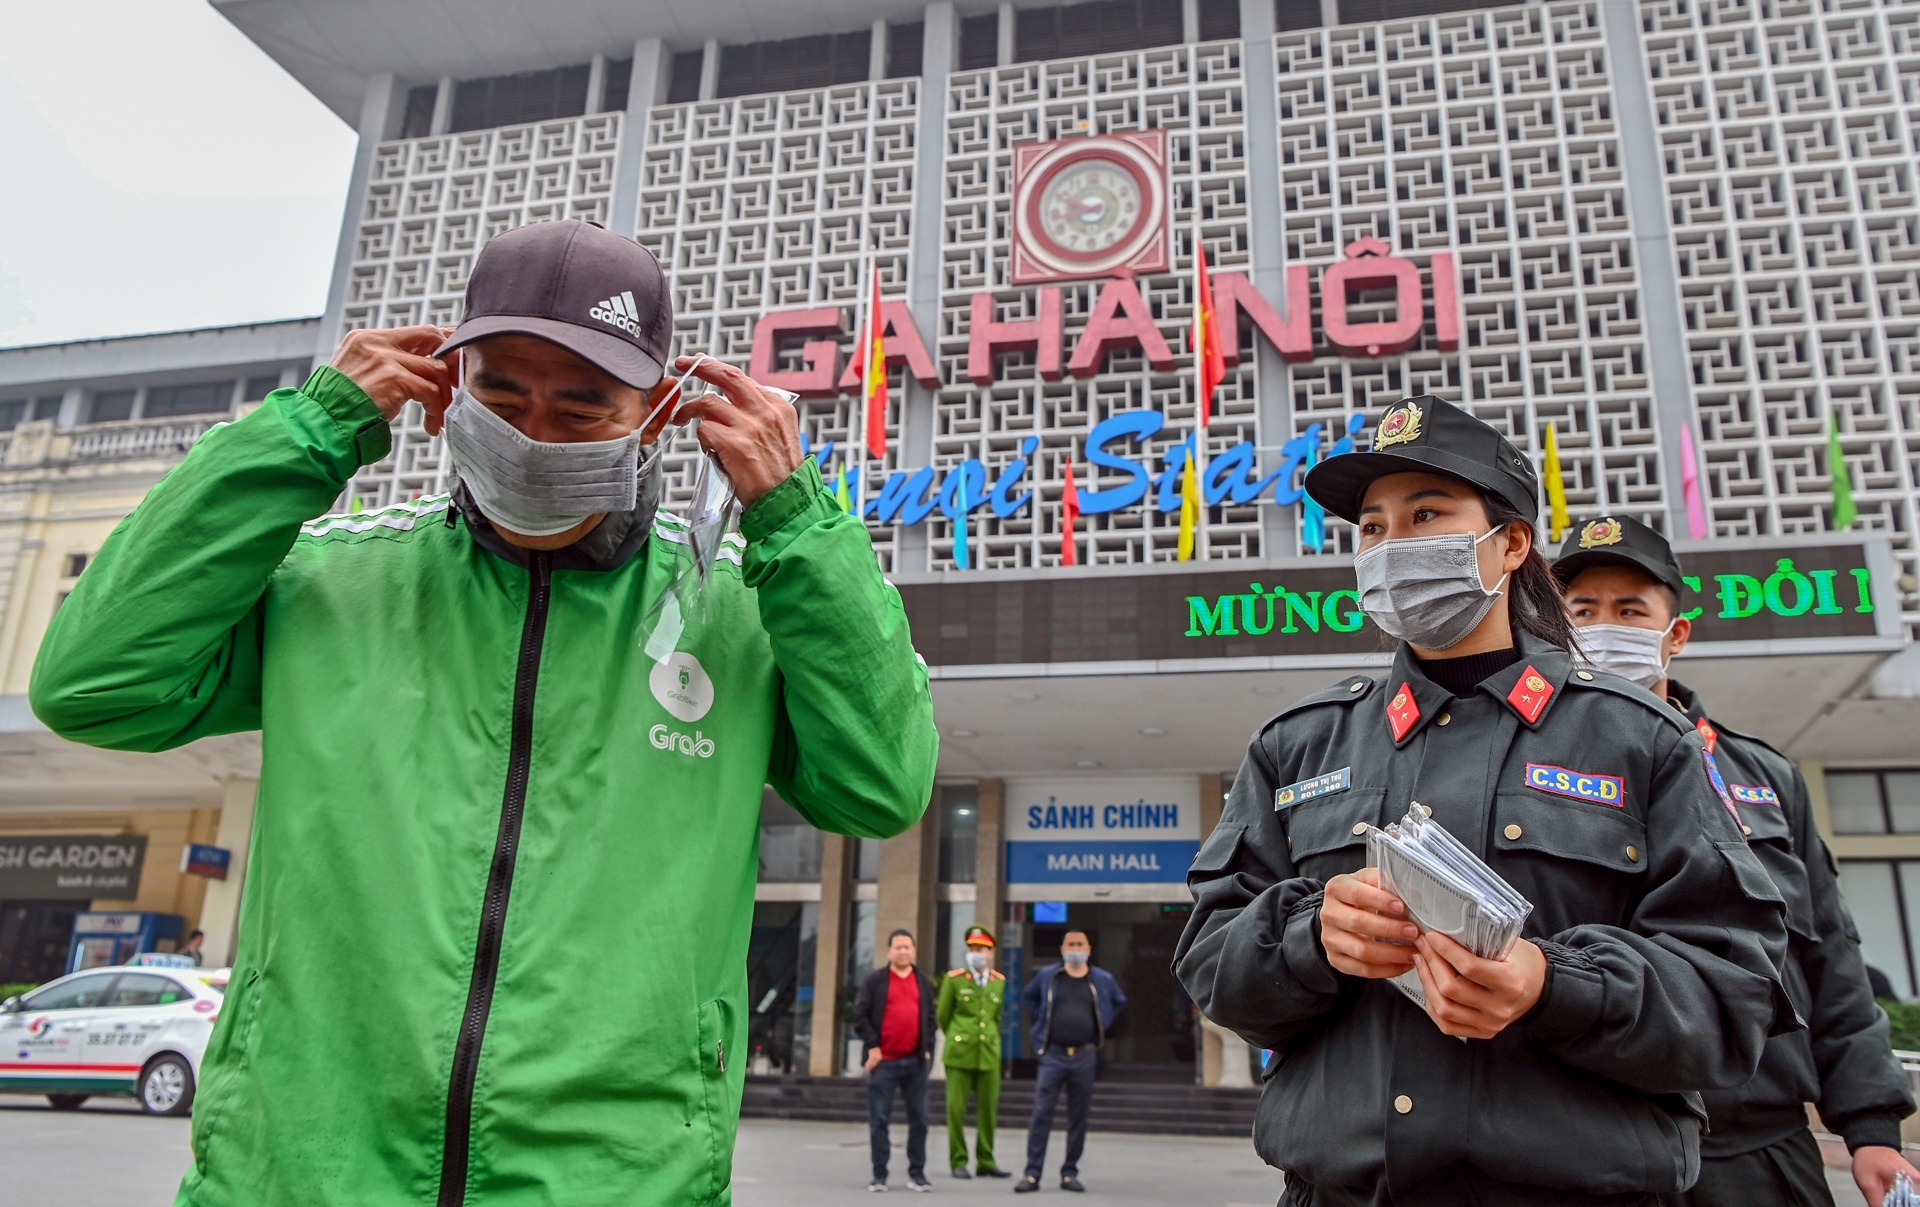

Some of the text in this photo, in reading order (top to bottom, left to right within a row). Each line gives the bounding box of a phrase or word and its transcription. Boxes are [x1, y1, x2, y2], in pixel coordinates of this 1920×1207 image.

[589, 306, 642, 339] adidas
[749, 299, 943, 399] GA
[1212, 235, 1459, 368] NỘI
[800, 409, 1375, 526] anoi Stati
[1185, 582, 1368, 637] MỪNG
[667, 690, 698, 707] GrabBike
[649, 723, 716, 759] Grab
[1532, 768, 1619, 800] C.S.C.Đ
[1027, 795, 1179, 830] SẢNH CHÍNH
[28, 844, 137, 869] GARDEN
[1047, 853, 1161, 871] MAIN HALL
